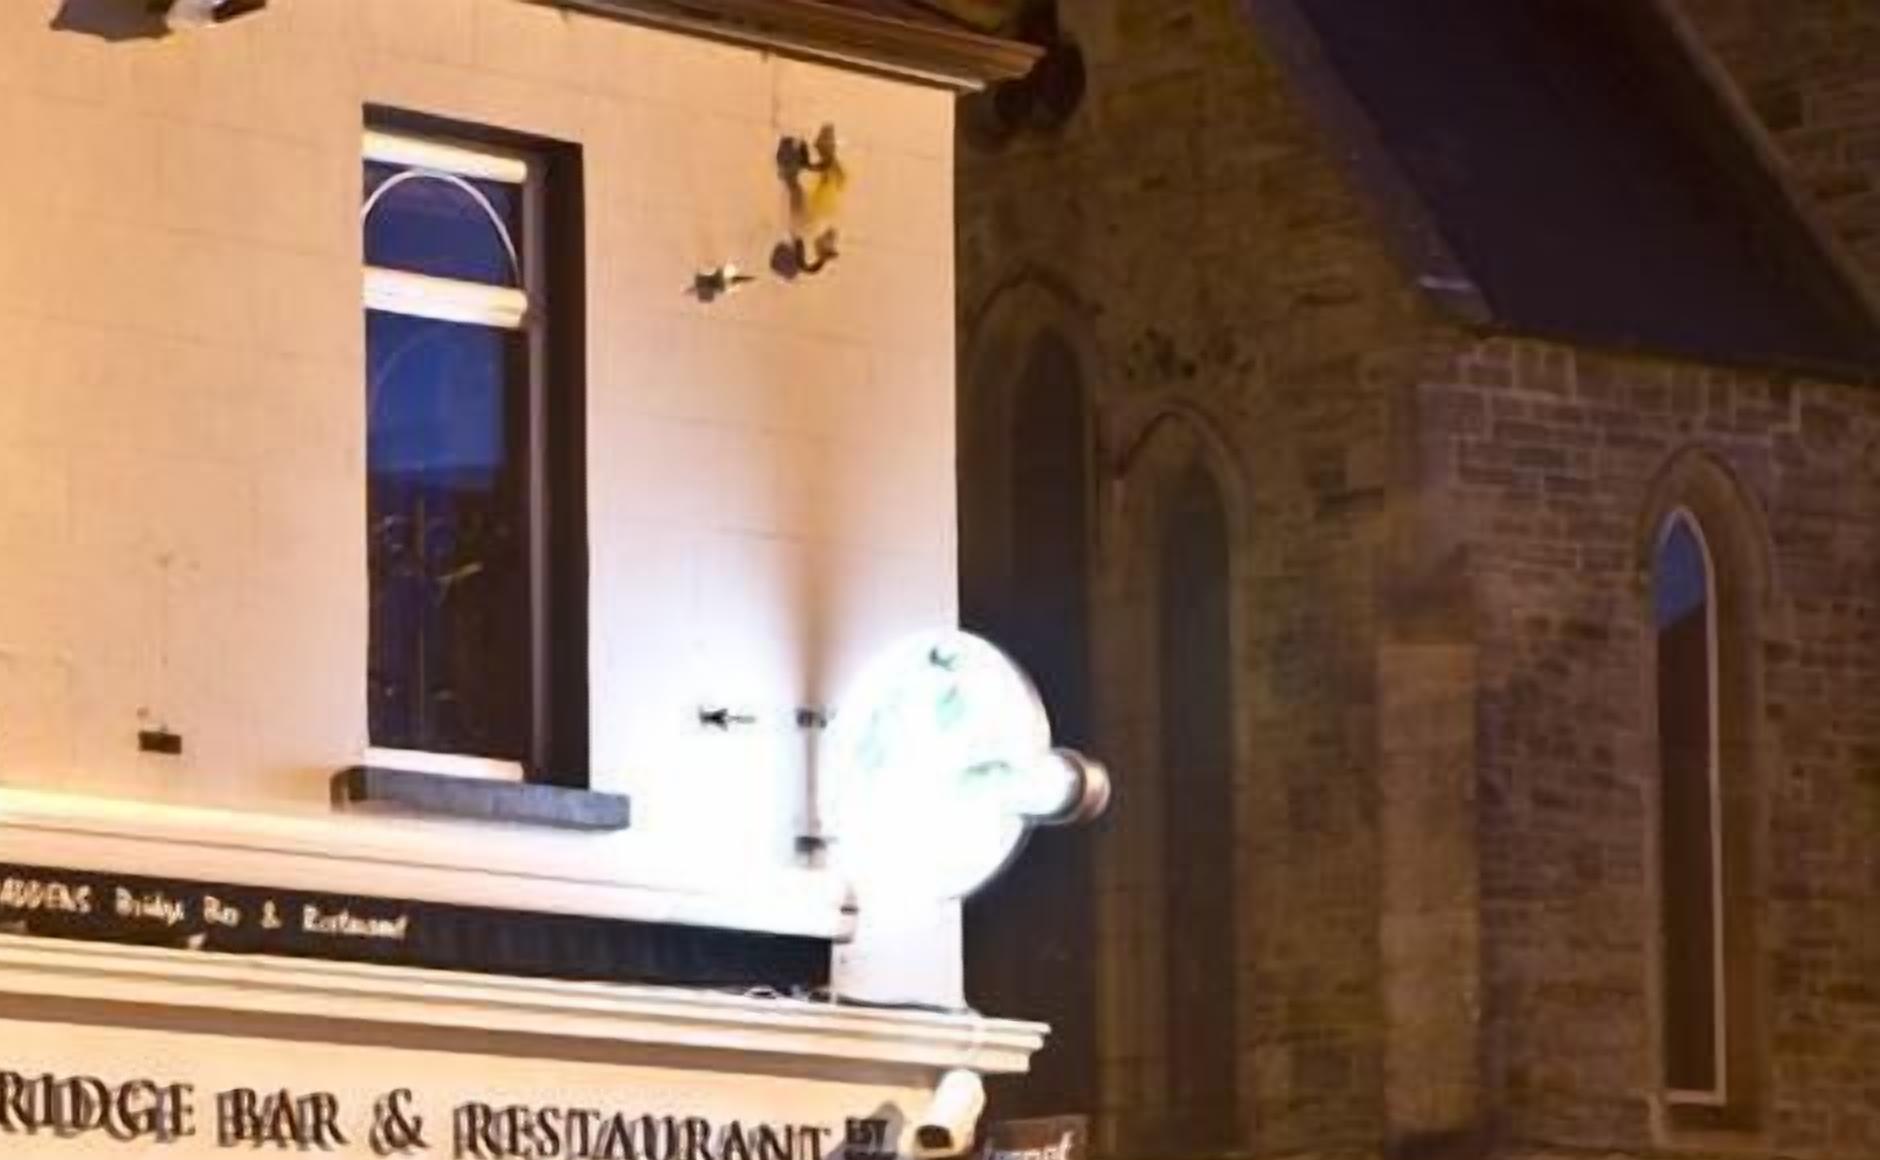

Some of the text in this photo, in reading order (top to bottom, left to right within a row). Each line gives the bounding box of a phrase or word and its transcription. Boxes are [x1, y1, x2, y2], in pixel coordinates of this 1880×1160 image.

[261, 899, 283, 929] &
[216, 1086, 351, 1151] BAR
[368, 1086, 432, 1157] &
